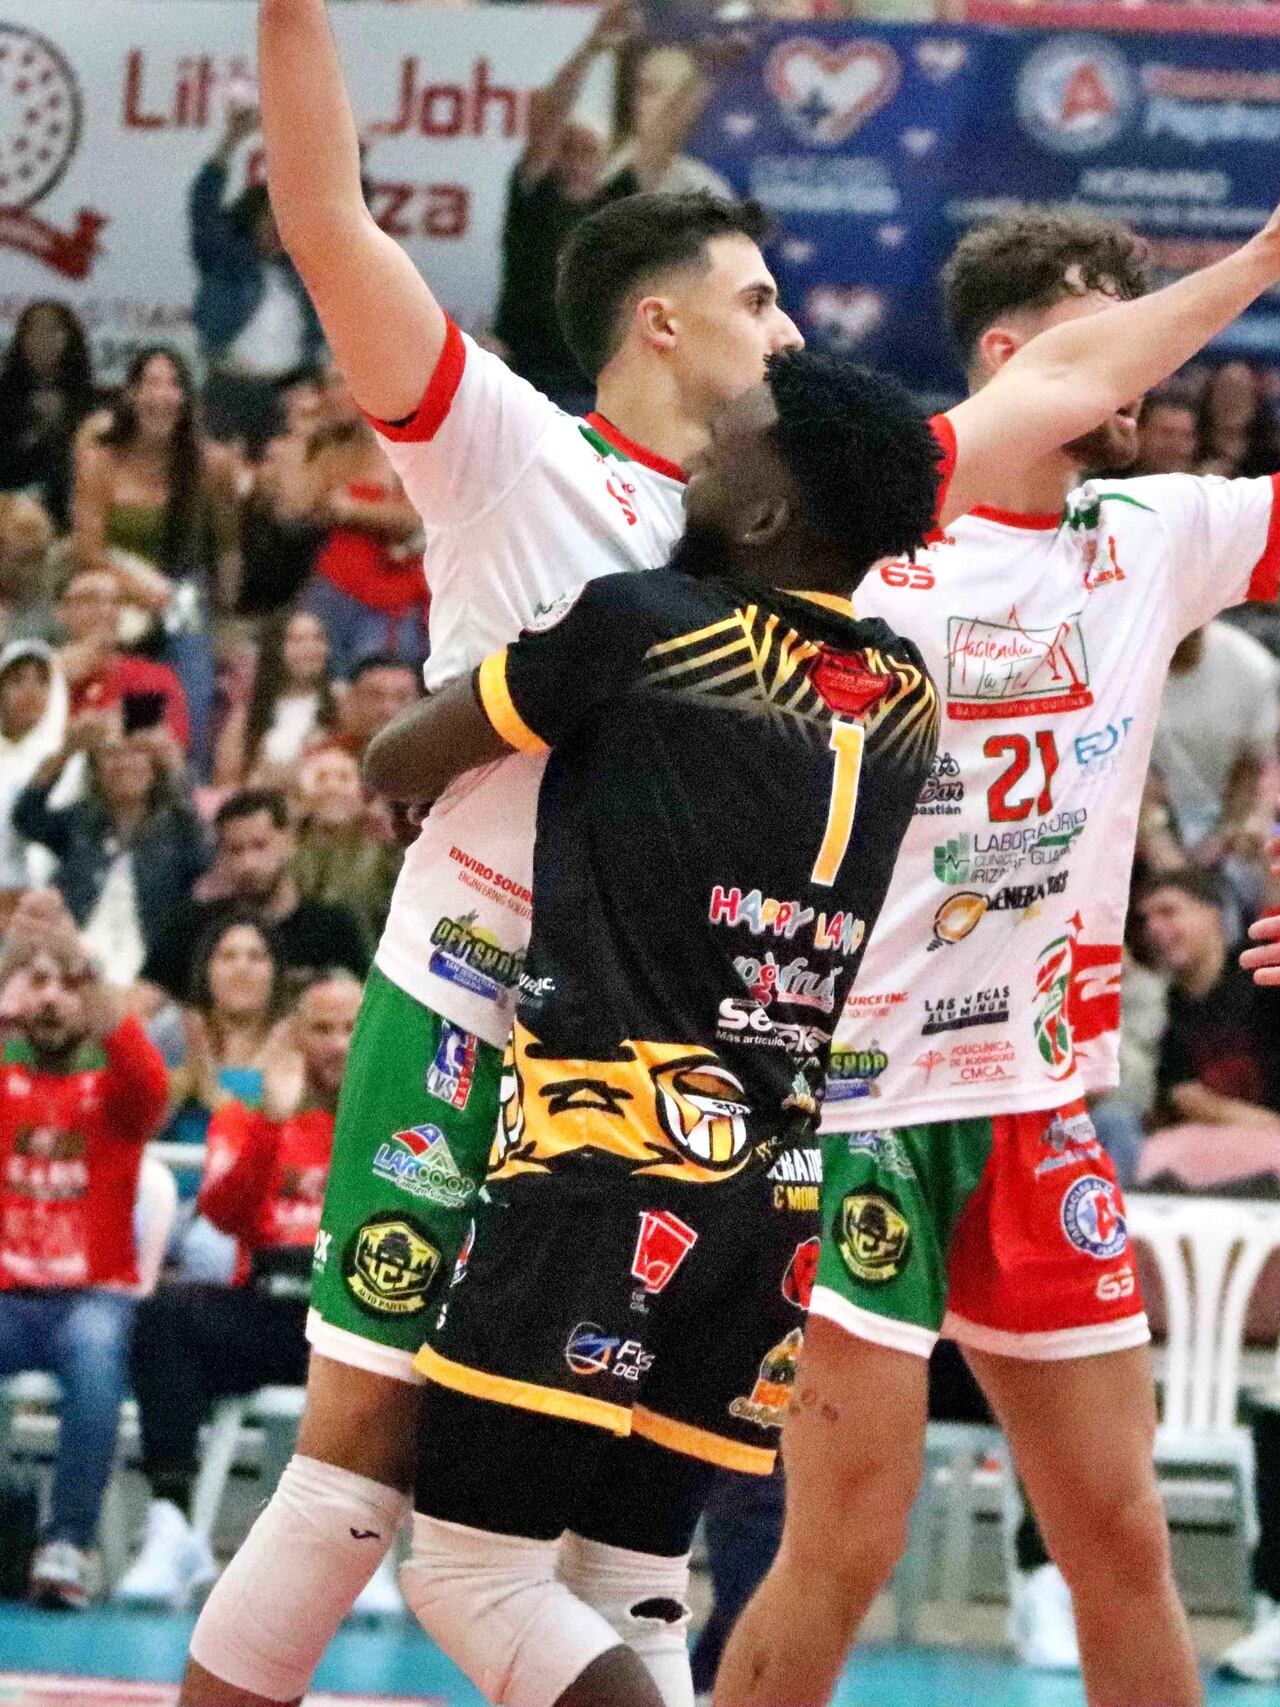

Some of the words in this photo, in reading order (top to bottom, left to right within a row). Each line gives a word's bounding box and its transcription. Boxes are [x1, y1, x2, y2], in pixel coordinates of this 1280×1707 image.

[370, 55, 530, 138] Joh
[810, 719, 865, 888] 1
[983, 730, 1060, 823] 21
[449, 846, 495, 881] ENVIRO
[492, 873, 535, 904] SOUR
[709, 885, 815, 939] HAPPY
[813, 911, 866, 956] LAND
[847, 993, 882, 1006] URCE
[925, 998, 955, 1012] LAS
[960, 1065, 1005, 1080] CMCA
